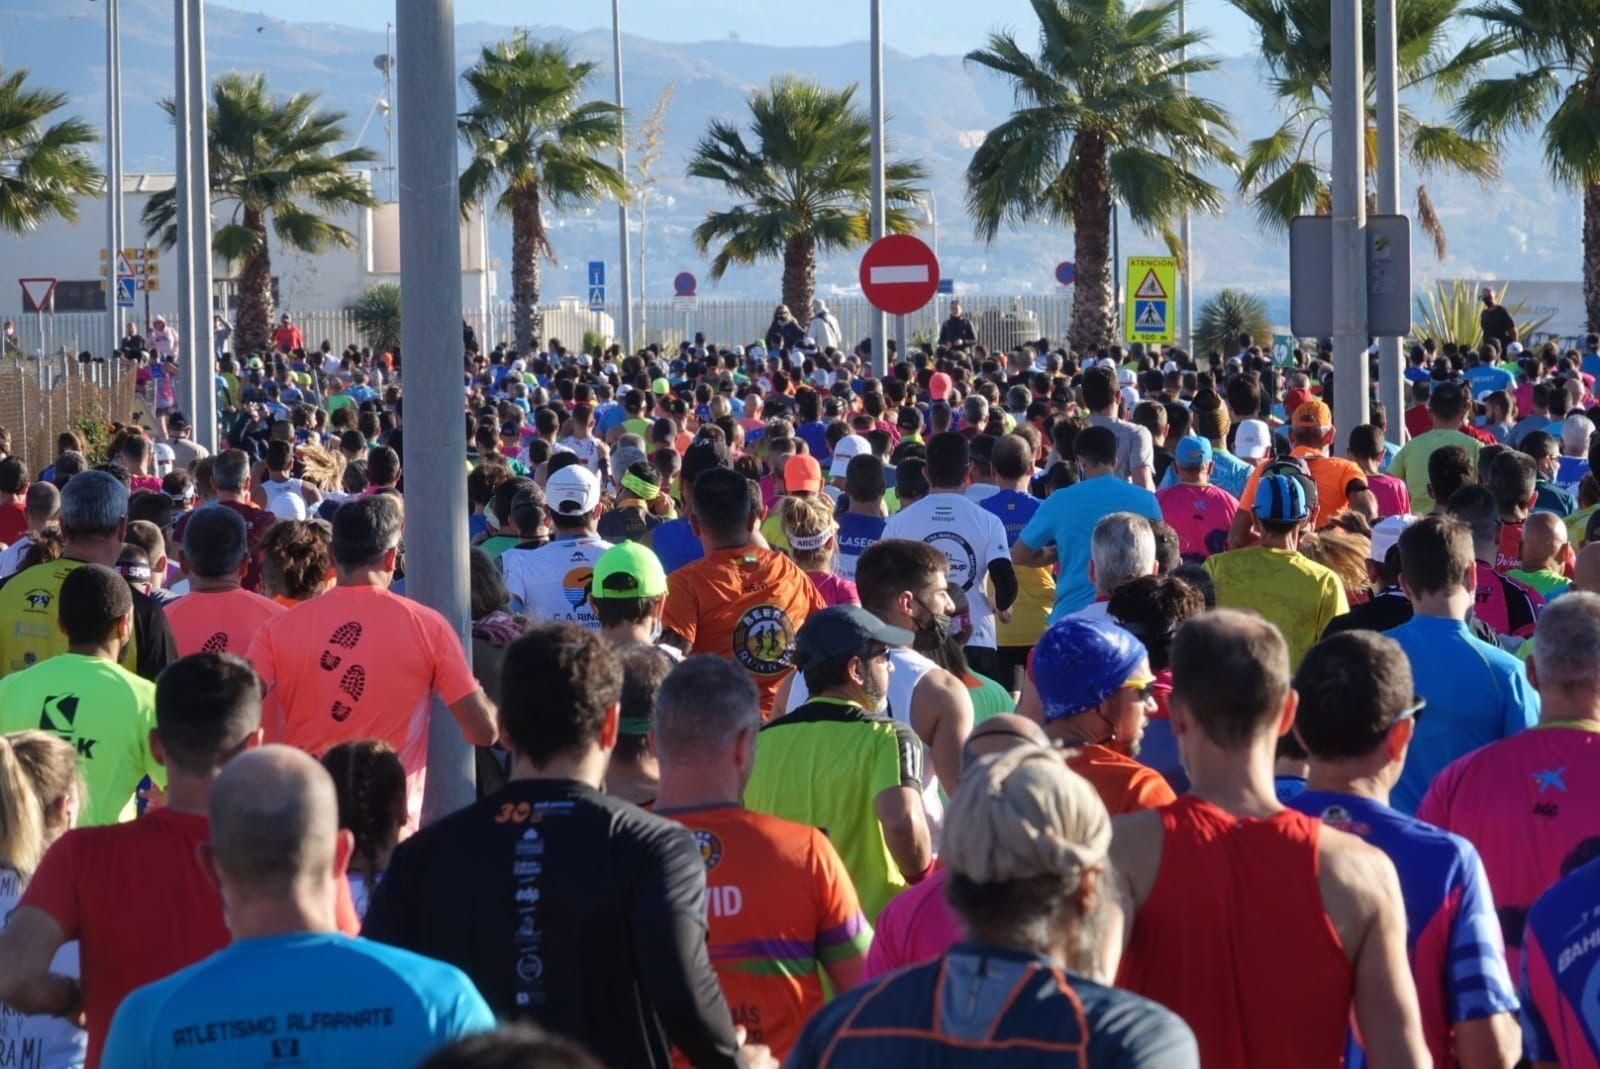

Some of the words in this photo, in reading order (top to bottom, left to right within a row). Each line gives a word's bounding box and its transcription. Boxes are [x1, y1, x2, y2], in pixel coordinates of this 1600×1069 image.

[1141, 333, 1156, 341] 100
[743, 608, 782, 627] BEER
[173, 1015, 277, 1048] ATLETISMO
[287, 1007, 394, 1033] ALFARNATE
